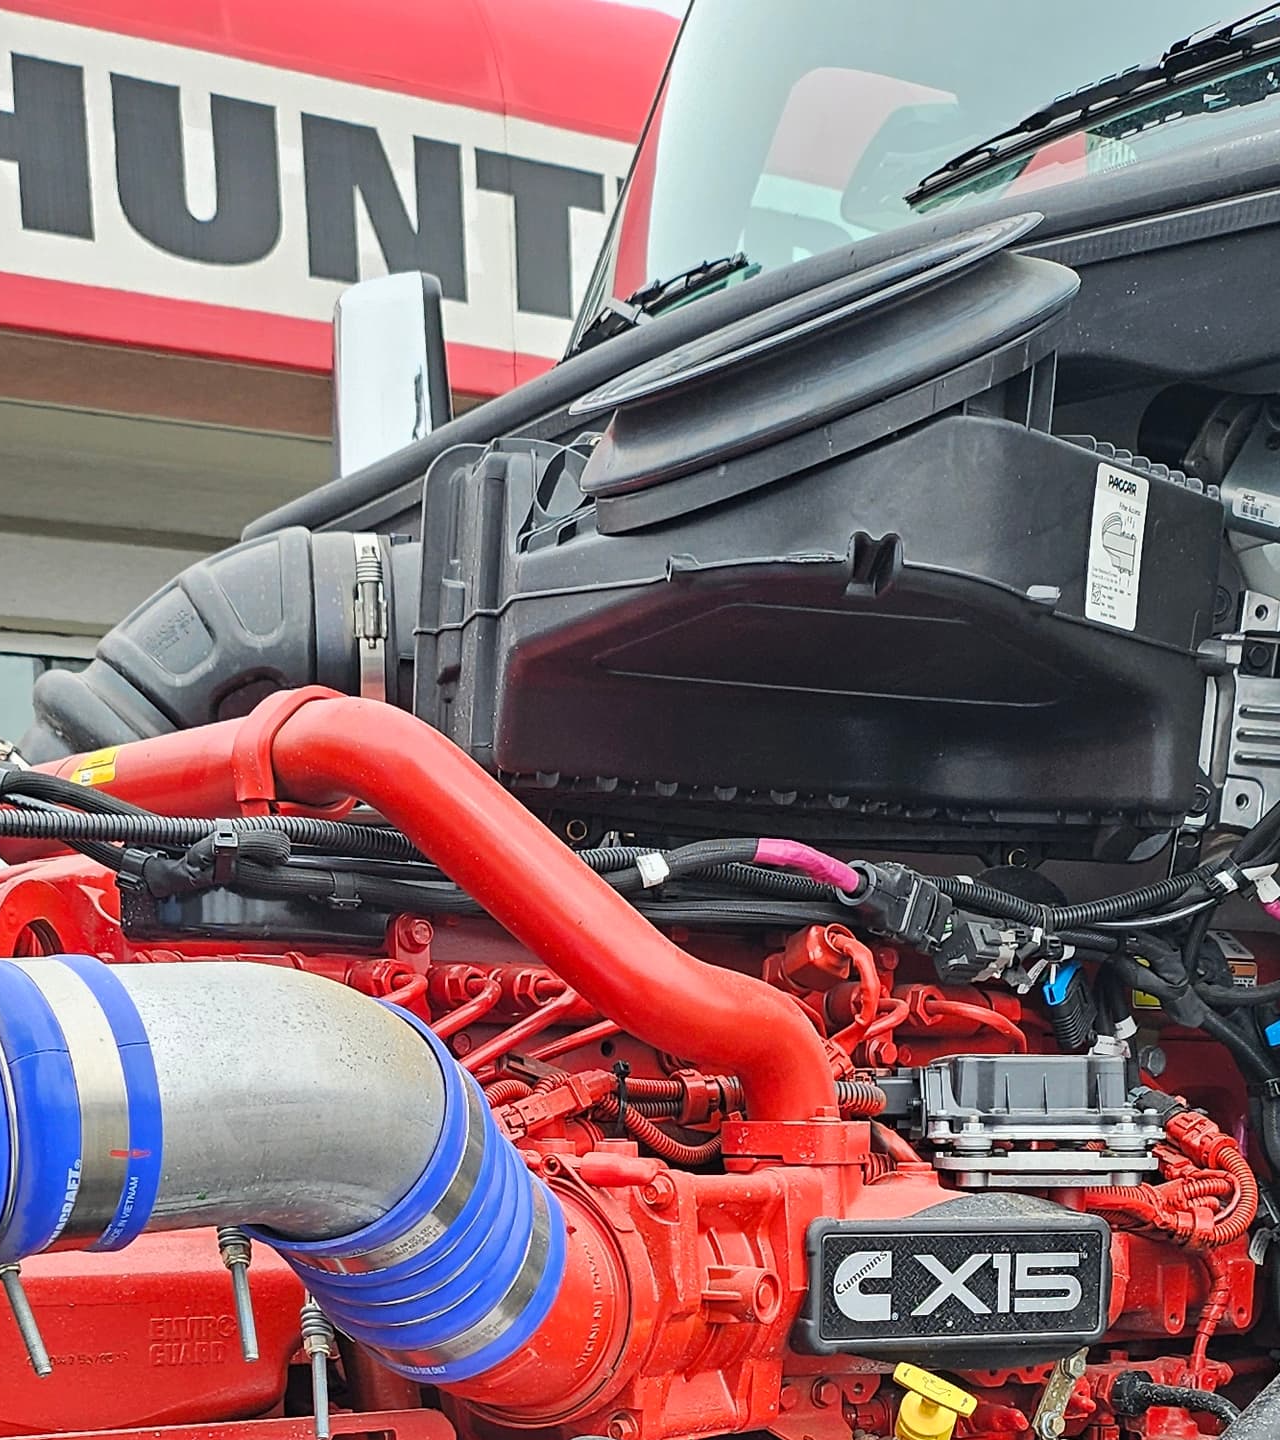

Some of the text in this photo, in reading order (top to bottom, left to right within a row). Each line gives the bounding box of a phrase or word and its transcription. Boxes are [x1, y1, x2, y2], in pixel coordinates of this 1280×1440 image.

[1108, 474, 1137, 497] PACCAR
[122, 1176, 140, 1223] VIETNAM
[833, 1249, 1083, 1317] Cummins X15
[149, 1342, 225, 1367] GUARD
